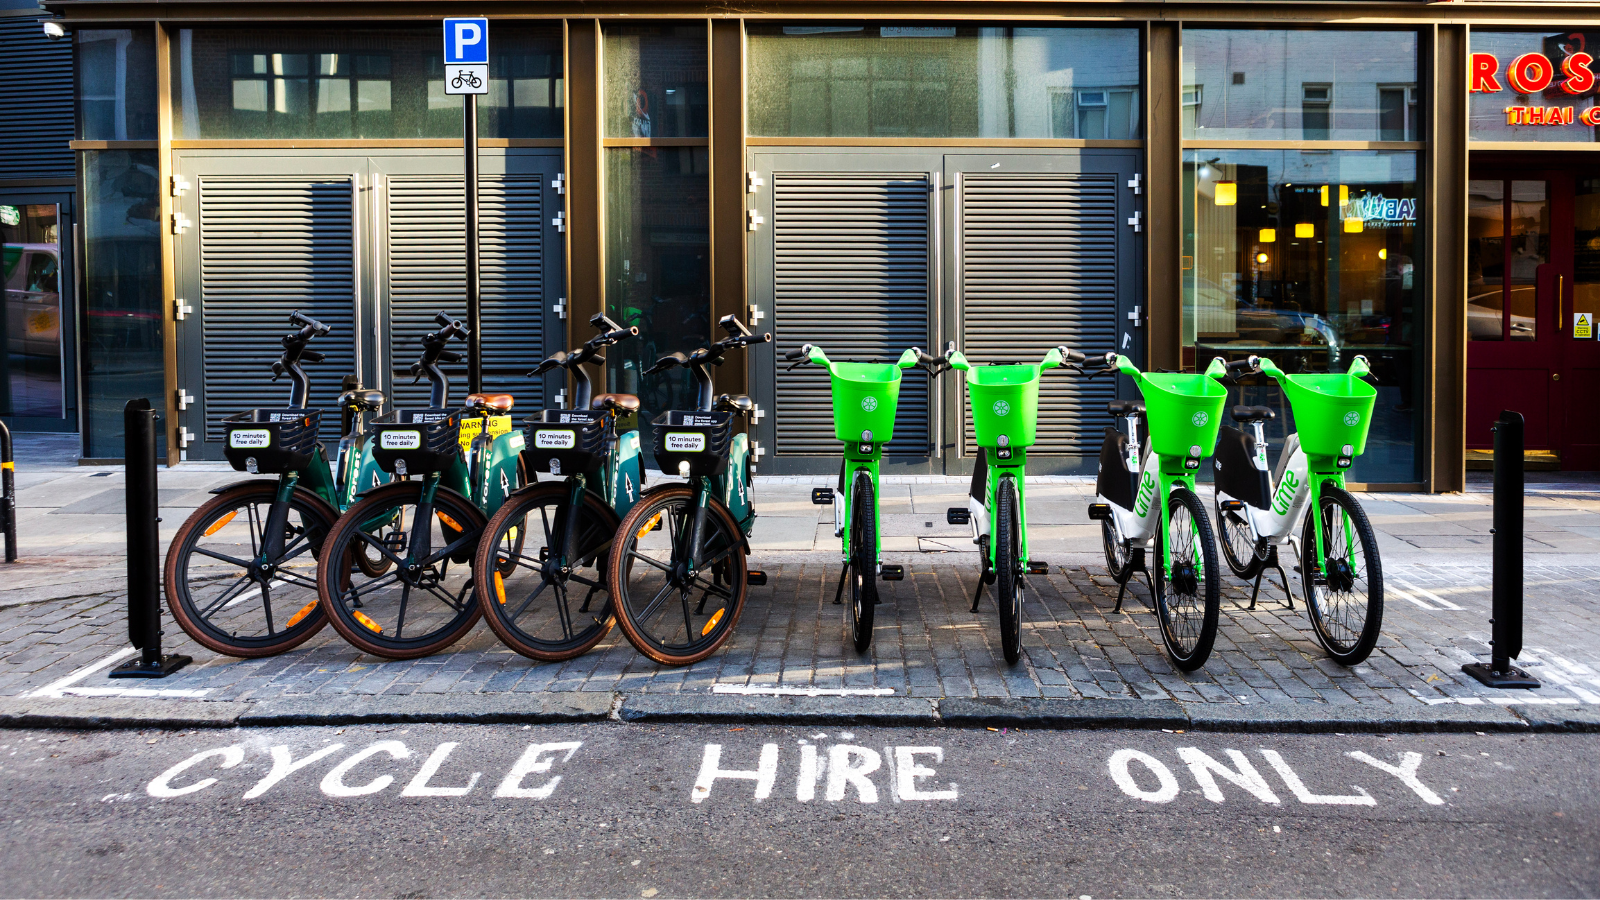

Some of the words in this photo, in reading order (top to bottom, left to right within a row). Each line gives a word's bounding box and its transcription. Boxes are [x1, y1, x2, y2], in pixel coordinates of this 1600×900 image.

[455, 23, 481, 59] P
[1470, 52, 1595, 94] ROS
[1504, 106, 1574, 125] THAI
[349, 452, 361, 503] forest
[146, 740, 583, 800] CYCLE
[691, 743, 959, 803] HIRE
[1107, 746, 1446, 806] ONLY
